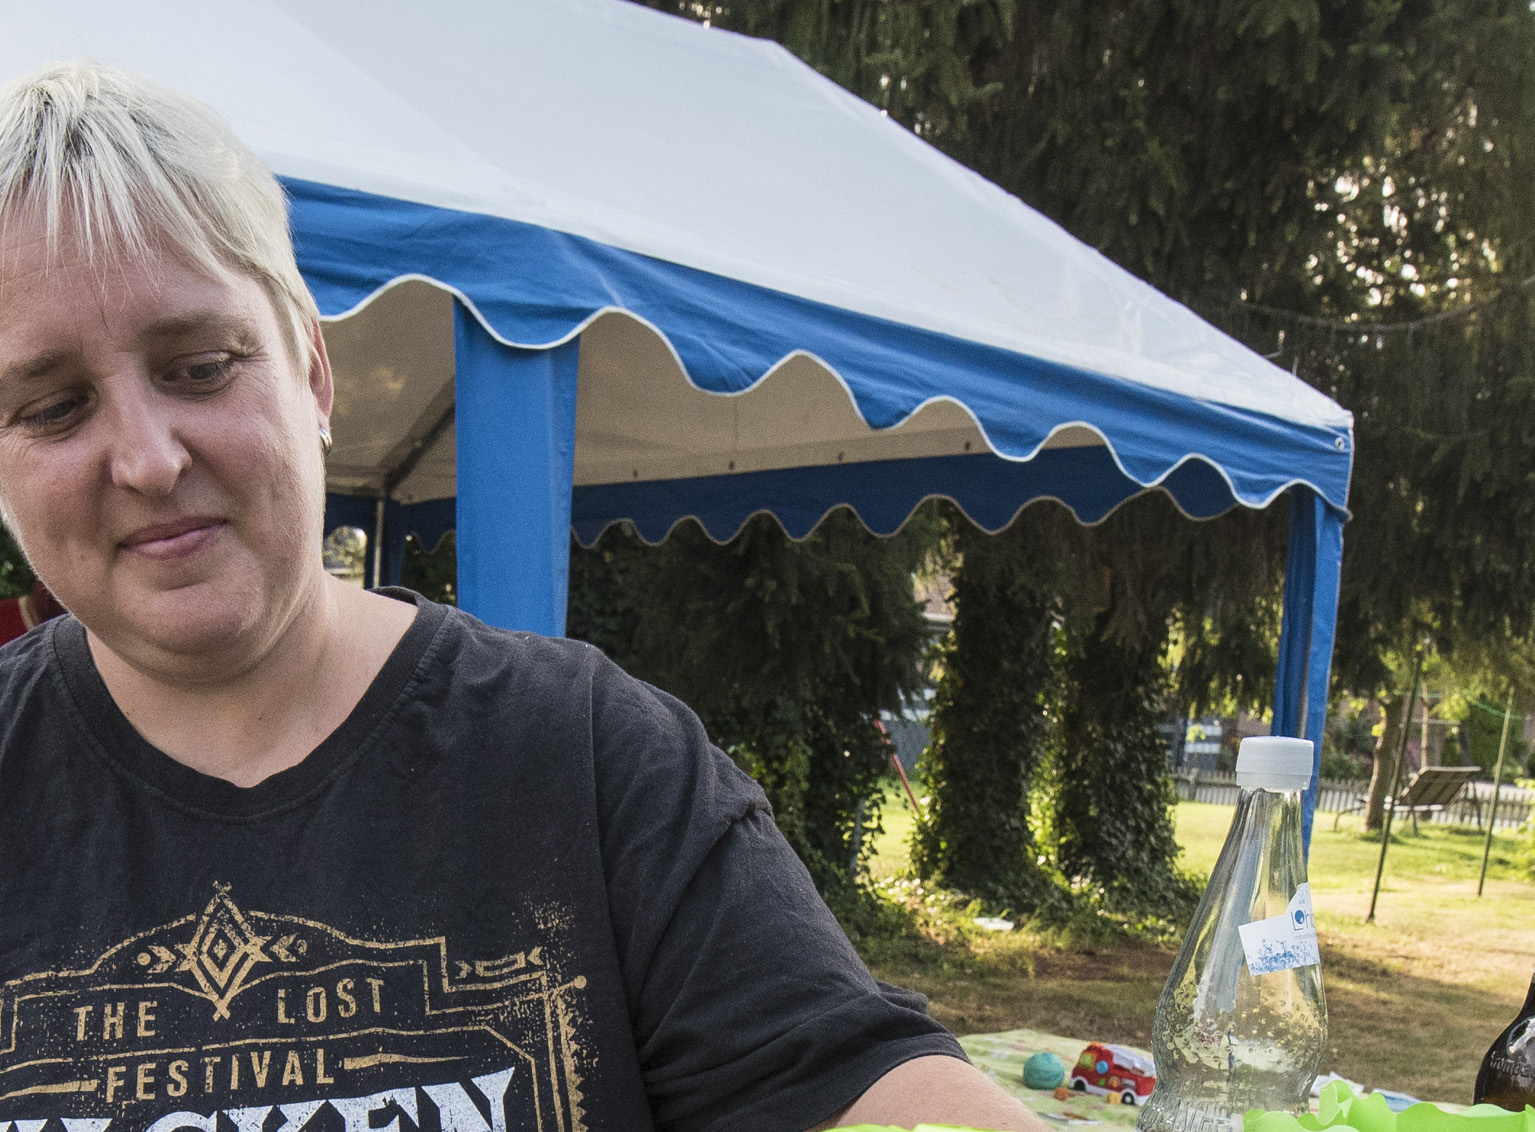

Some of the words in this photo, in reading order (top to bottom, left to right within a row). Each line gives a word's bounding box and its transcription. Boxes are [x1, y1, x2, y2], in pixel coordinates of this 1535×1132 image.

[73, 1001, 158, 1041] THE
[277, 978, 384, 1024] LOST
[106, 1049, 334, 1103] FESTIVAL
